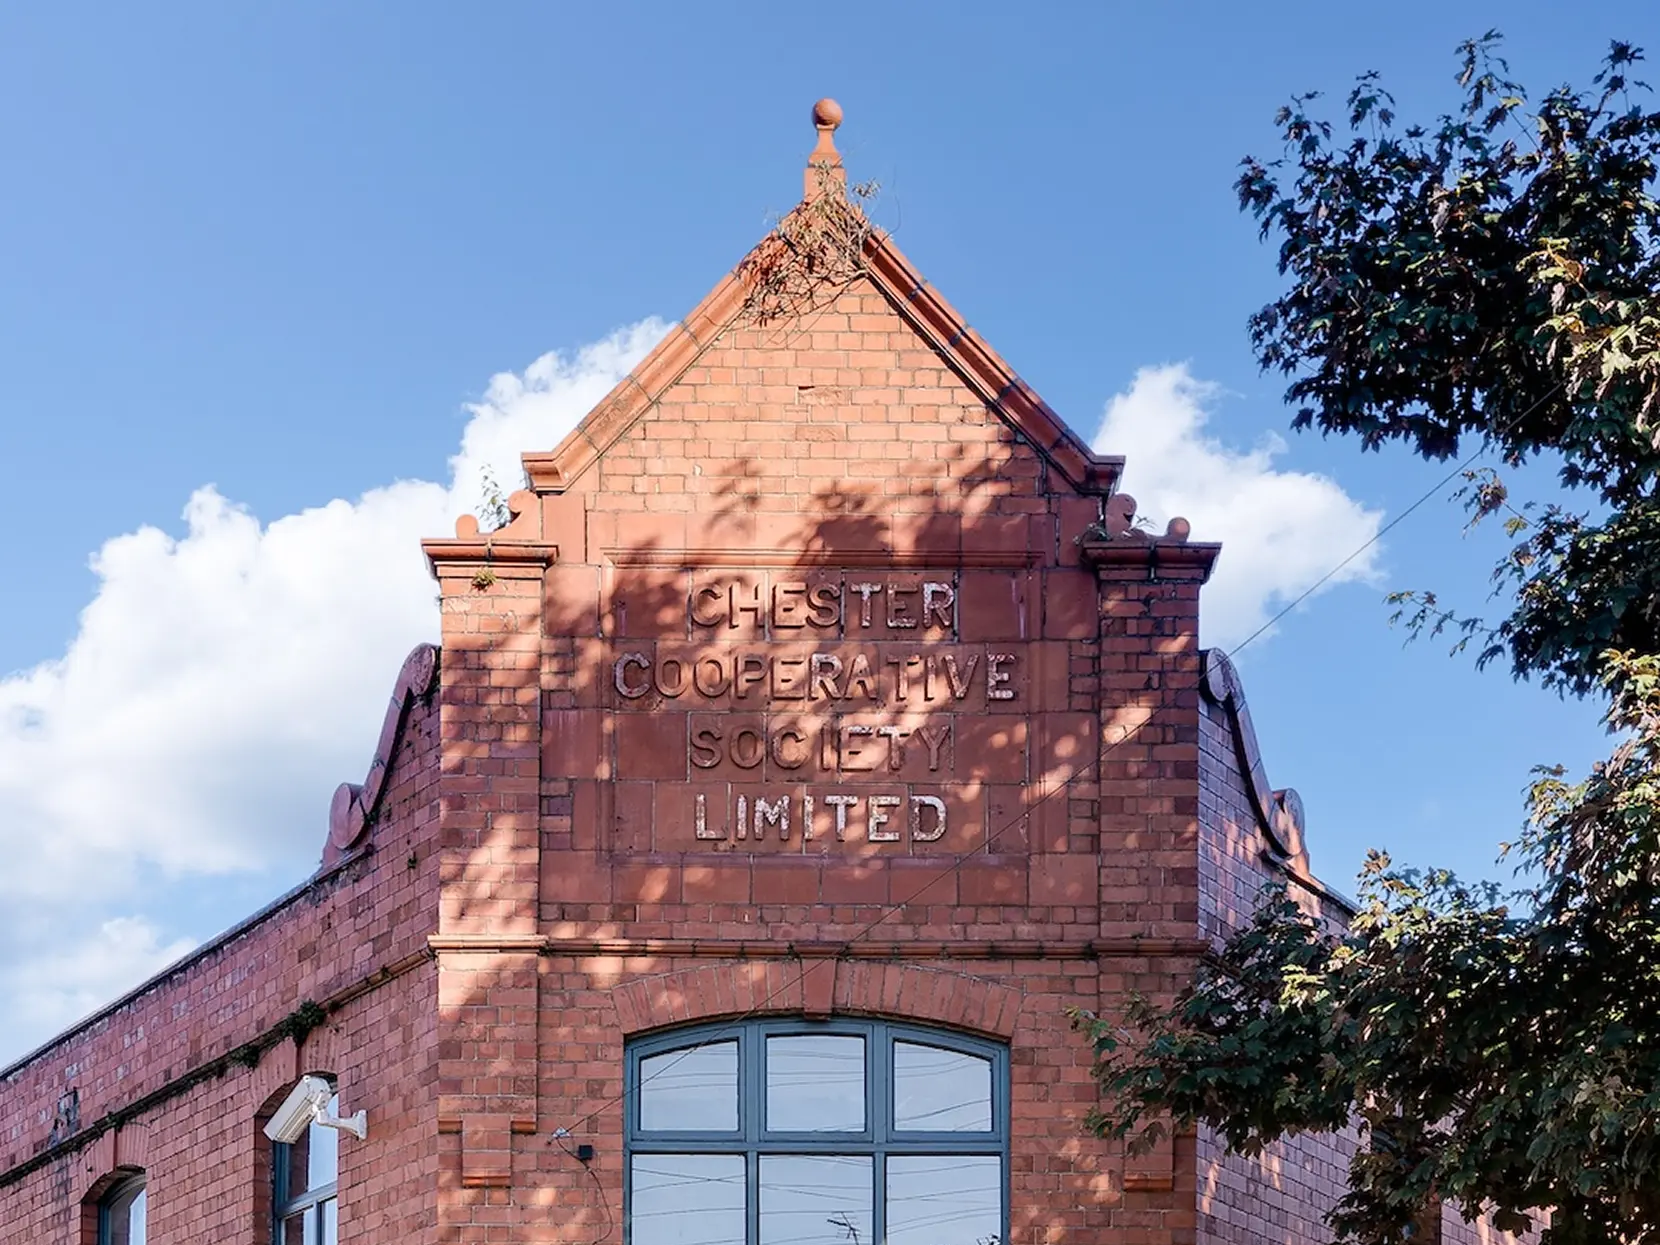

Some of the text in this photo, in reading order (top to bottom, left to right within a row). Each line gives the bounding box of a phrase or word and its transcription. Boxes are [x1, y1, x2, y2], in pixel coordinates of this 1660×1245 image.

[690, 580, 955, 630] CHESTER
[612, 651, 1018, 702] COOPERATIVE
[690, 724, 953, 773] SOCIETY
[695, 793, 948, 842] LIMITED
